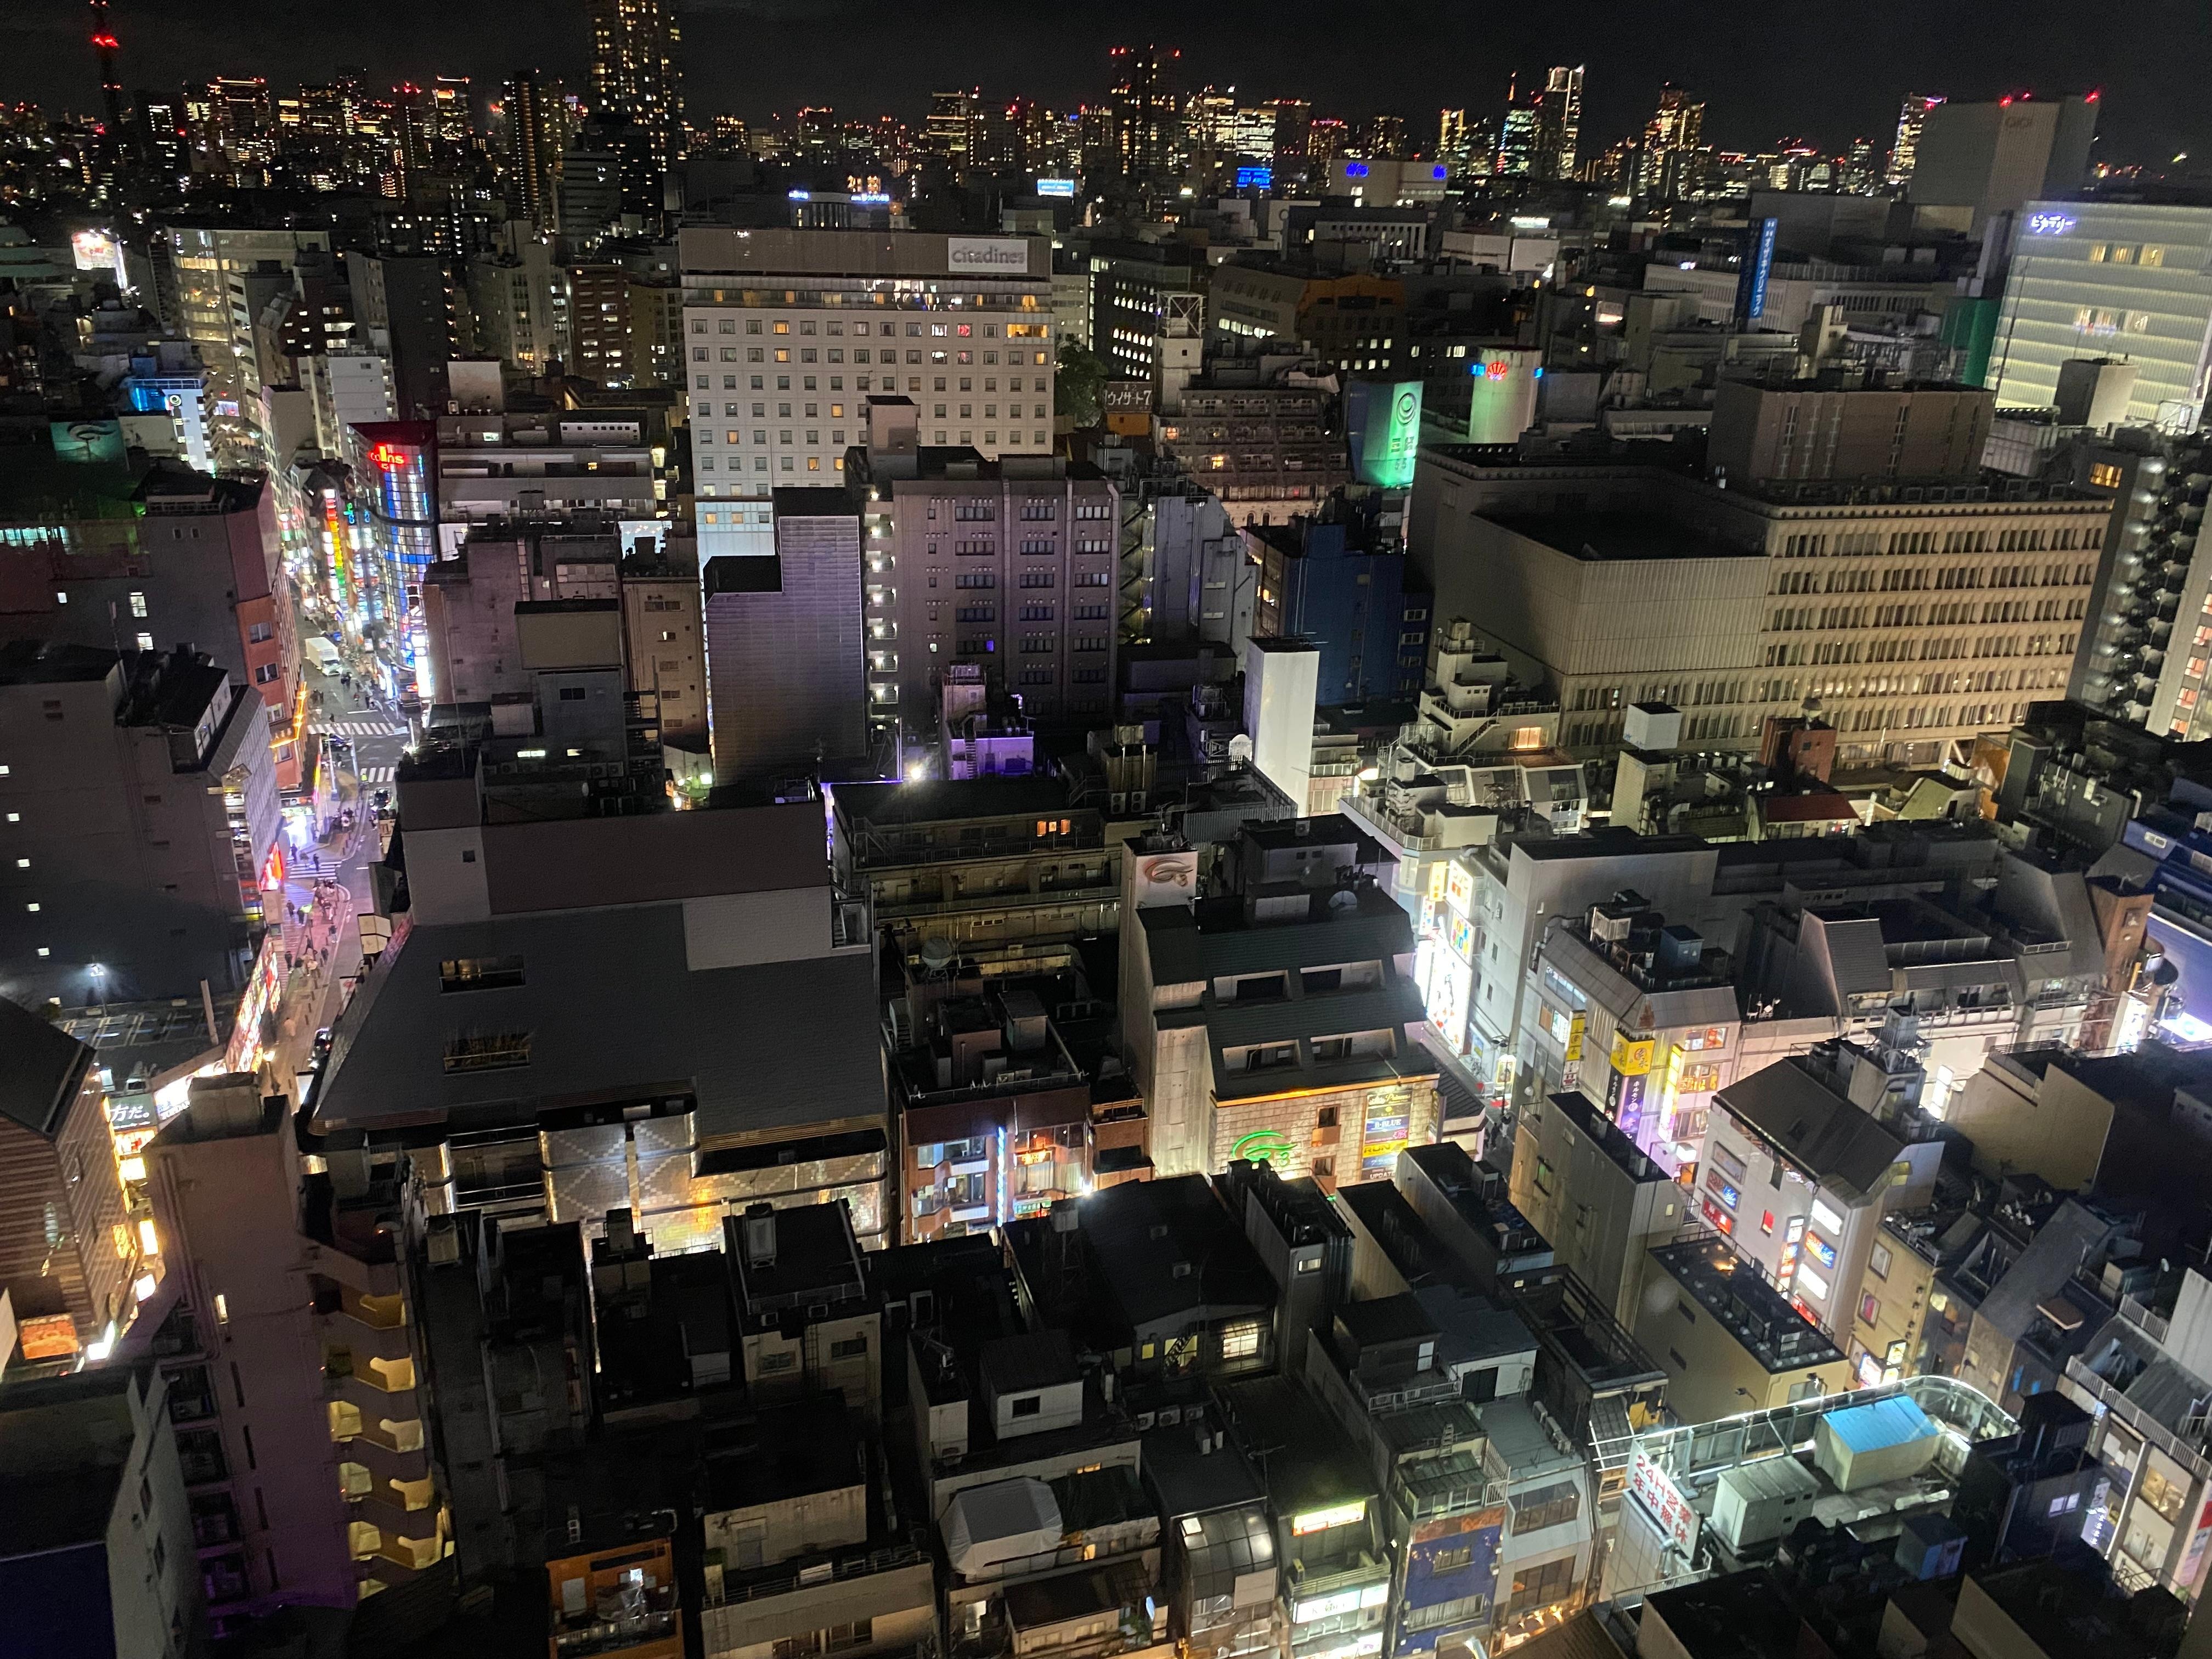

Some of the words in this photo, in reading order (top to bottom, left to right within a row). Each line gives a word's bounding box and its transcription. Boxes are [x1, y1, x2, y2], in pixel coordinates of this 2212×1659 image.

[2031, 214, 2076, 235] ピカデリー
[1631, 1080, 1641, 1103] ホルモン
[110, 1104, 150, 1122] 方だ。
